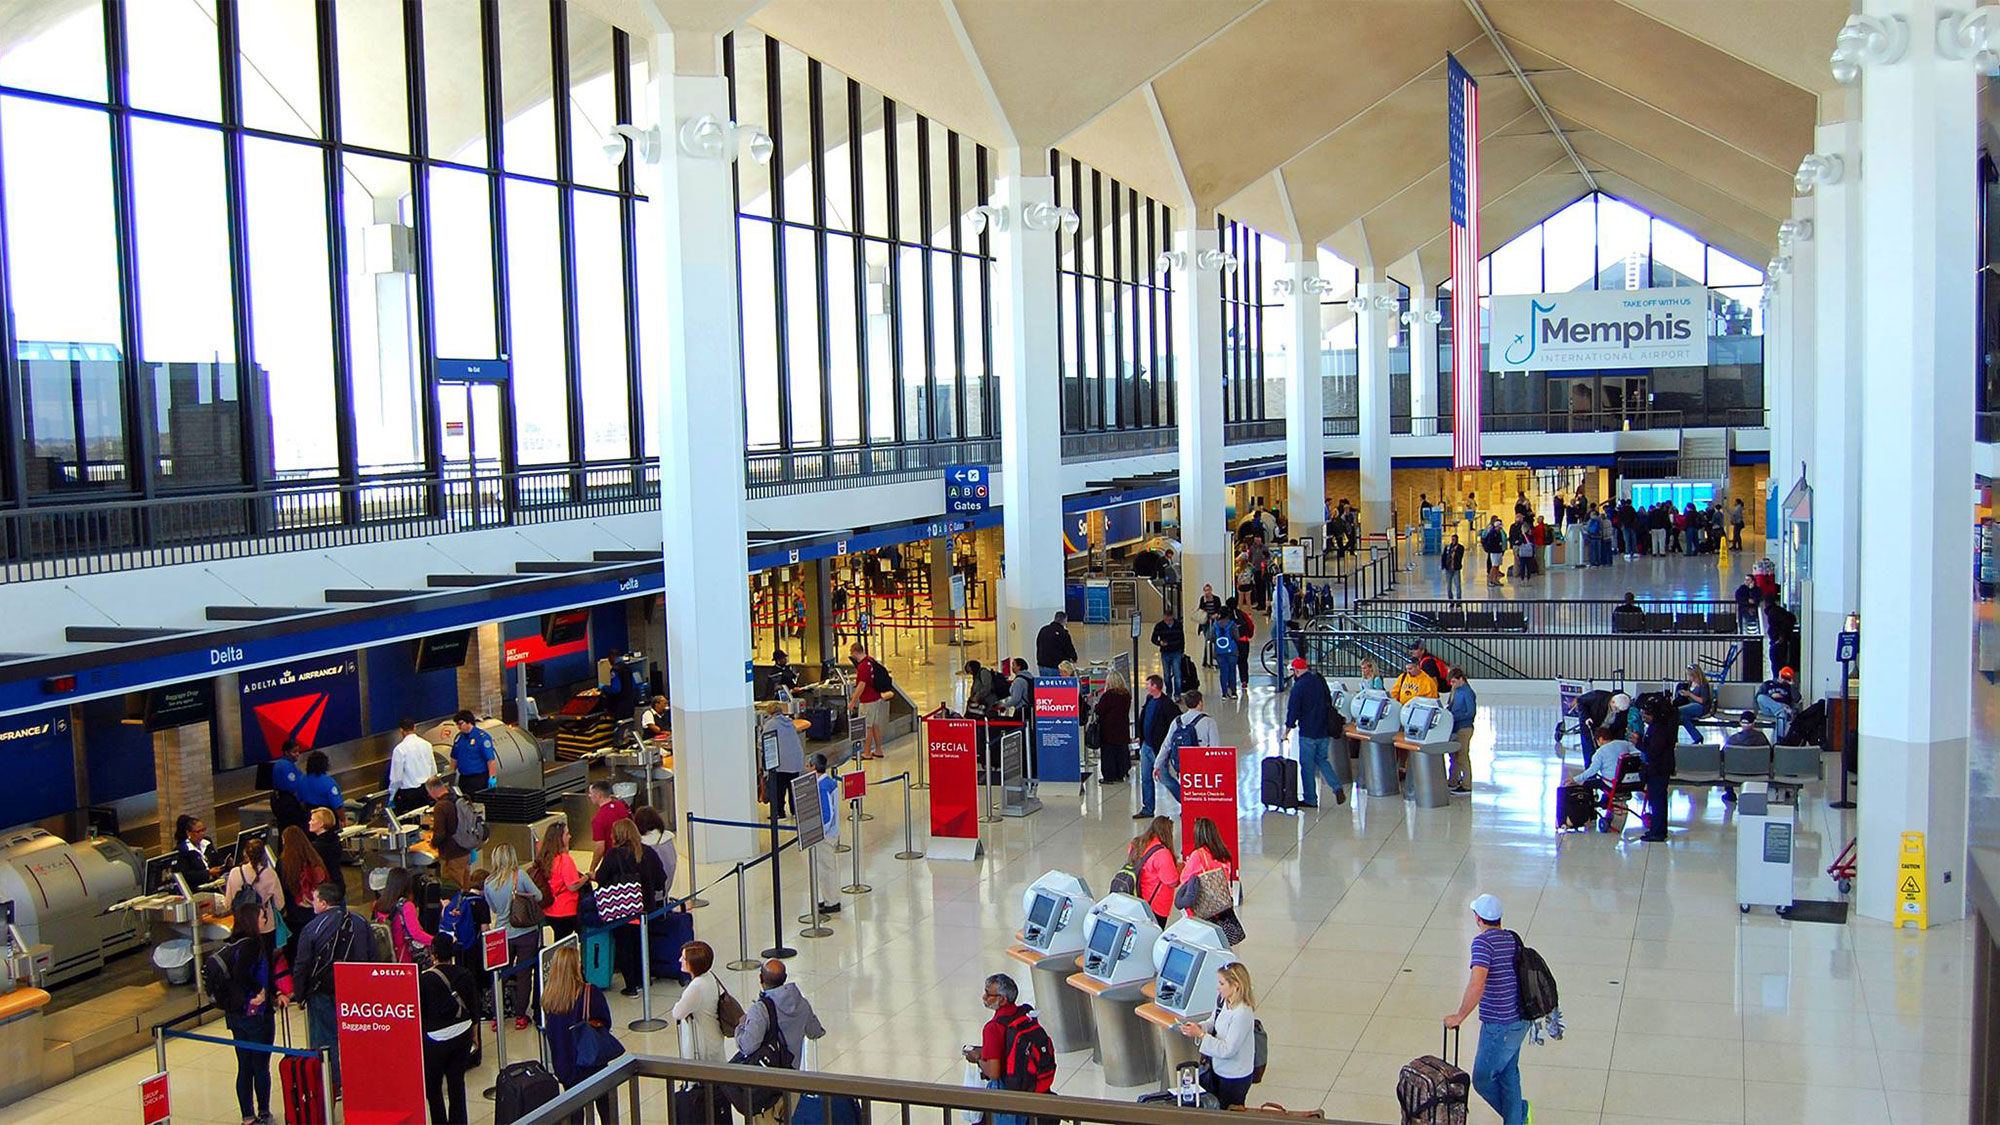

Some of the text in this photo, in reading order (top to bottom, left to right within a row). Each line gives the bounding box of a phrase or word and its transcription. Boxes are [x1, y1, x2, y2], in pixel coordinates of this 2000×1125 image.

[1680, 298, 1692, 306] US
[1542, 313, 1691, 349] Memphis
[1541, 350, 1690, 362] INTERNATIONAL AIRPORT
[950, 486, 985, 496] A B C
[954, 501, 982, 510] Gates
[210, 646, 243, 664] Delta
[252, 679, 277, 690] DELTA
[930, 742, 968, 752] SPECIAL
[1183, 774, 1223, 788] SELF
[340, 1003, 416, 1018] BAGGAGE
[342, 1022, 390, 1032] Baggage Drop
